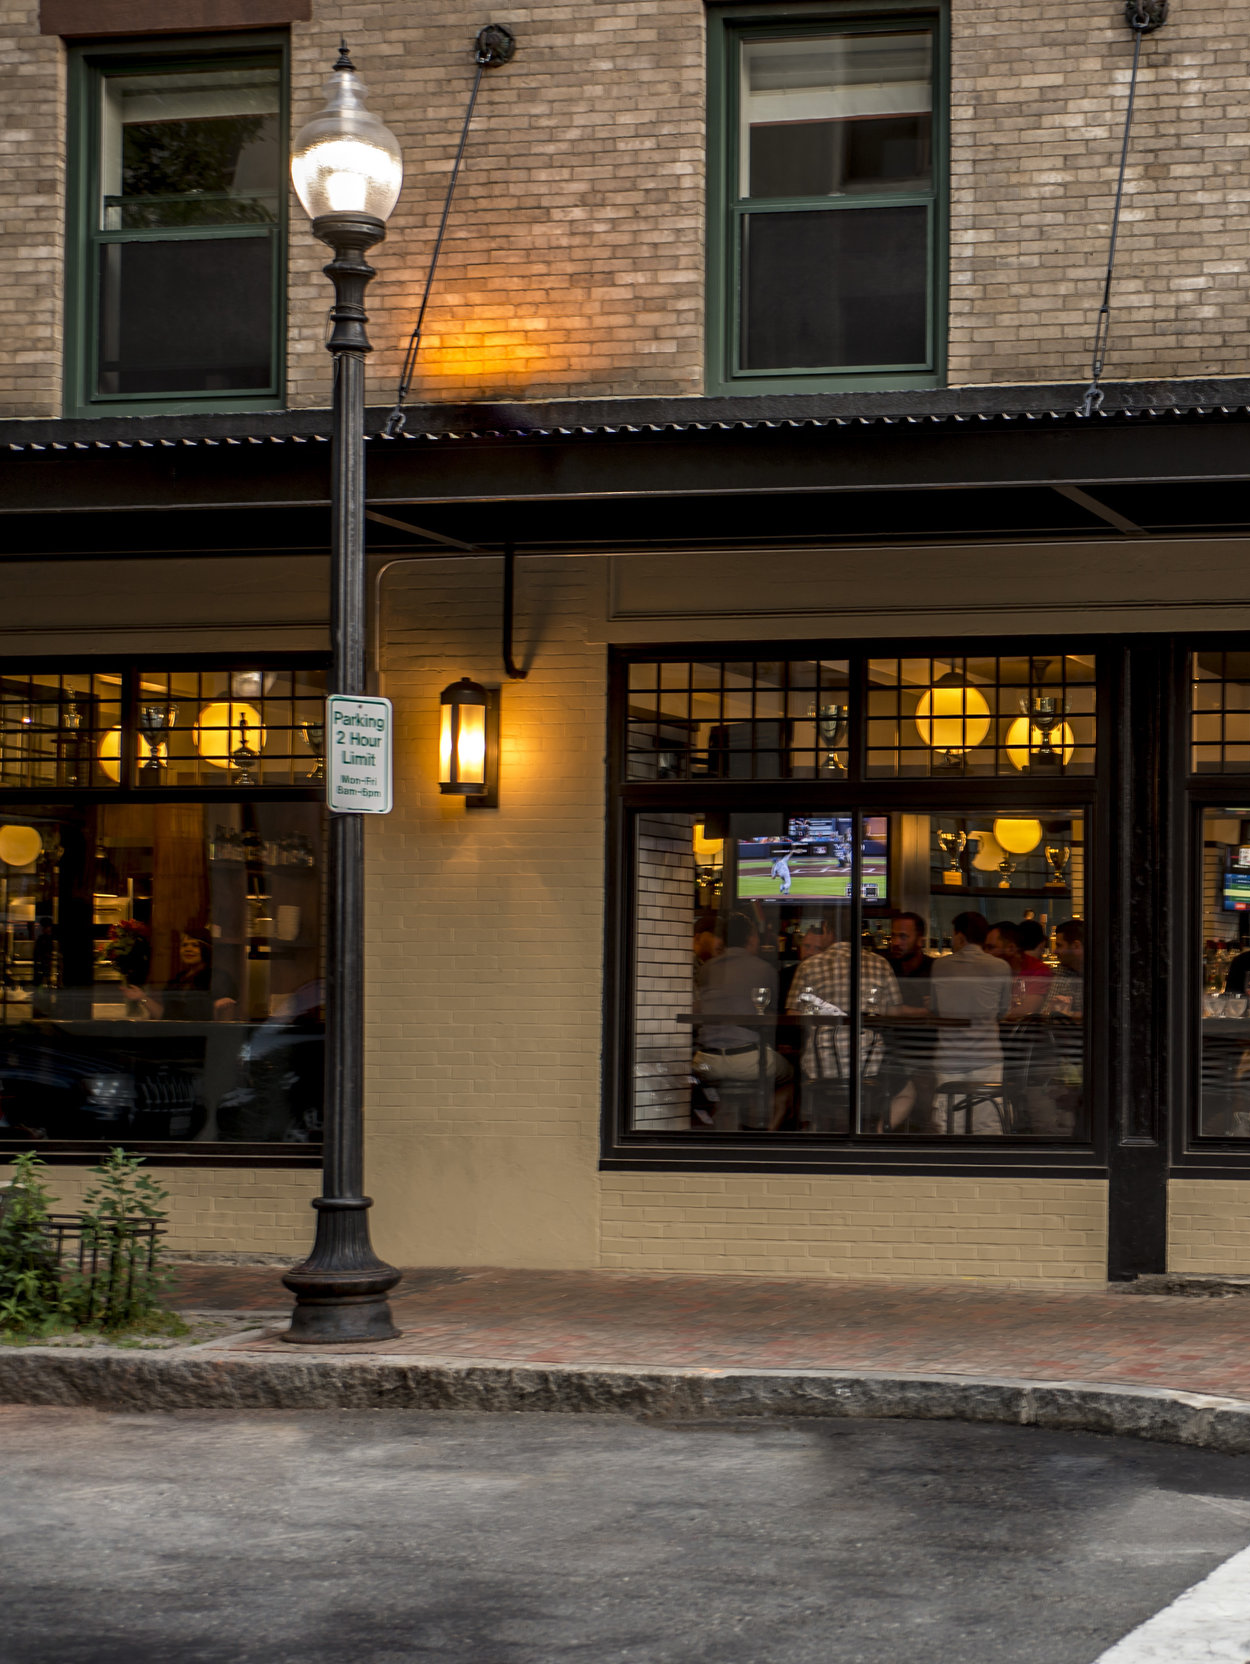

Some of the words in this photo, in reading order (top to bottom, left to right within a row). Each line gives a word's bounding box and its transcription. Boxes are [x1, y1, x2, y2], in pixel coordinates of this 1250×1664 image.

[333, 711, 385, 732] Parking
[336, 730, 346, 744] 2
[349, 732, 382, 747] Hour
[341, 750, 376, 766] Limit
[341, 775, 377, 785] Mon-Fri
